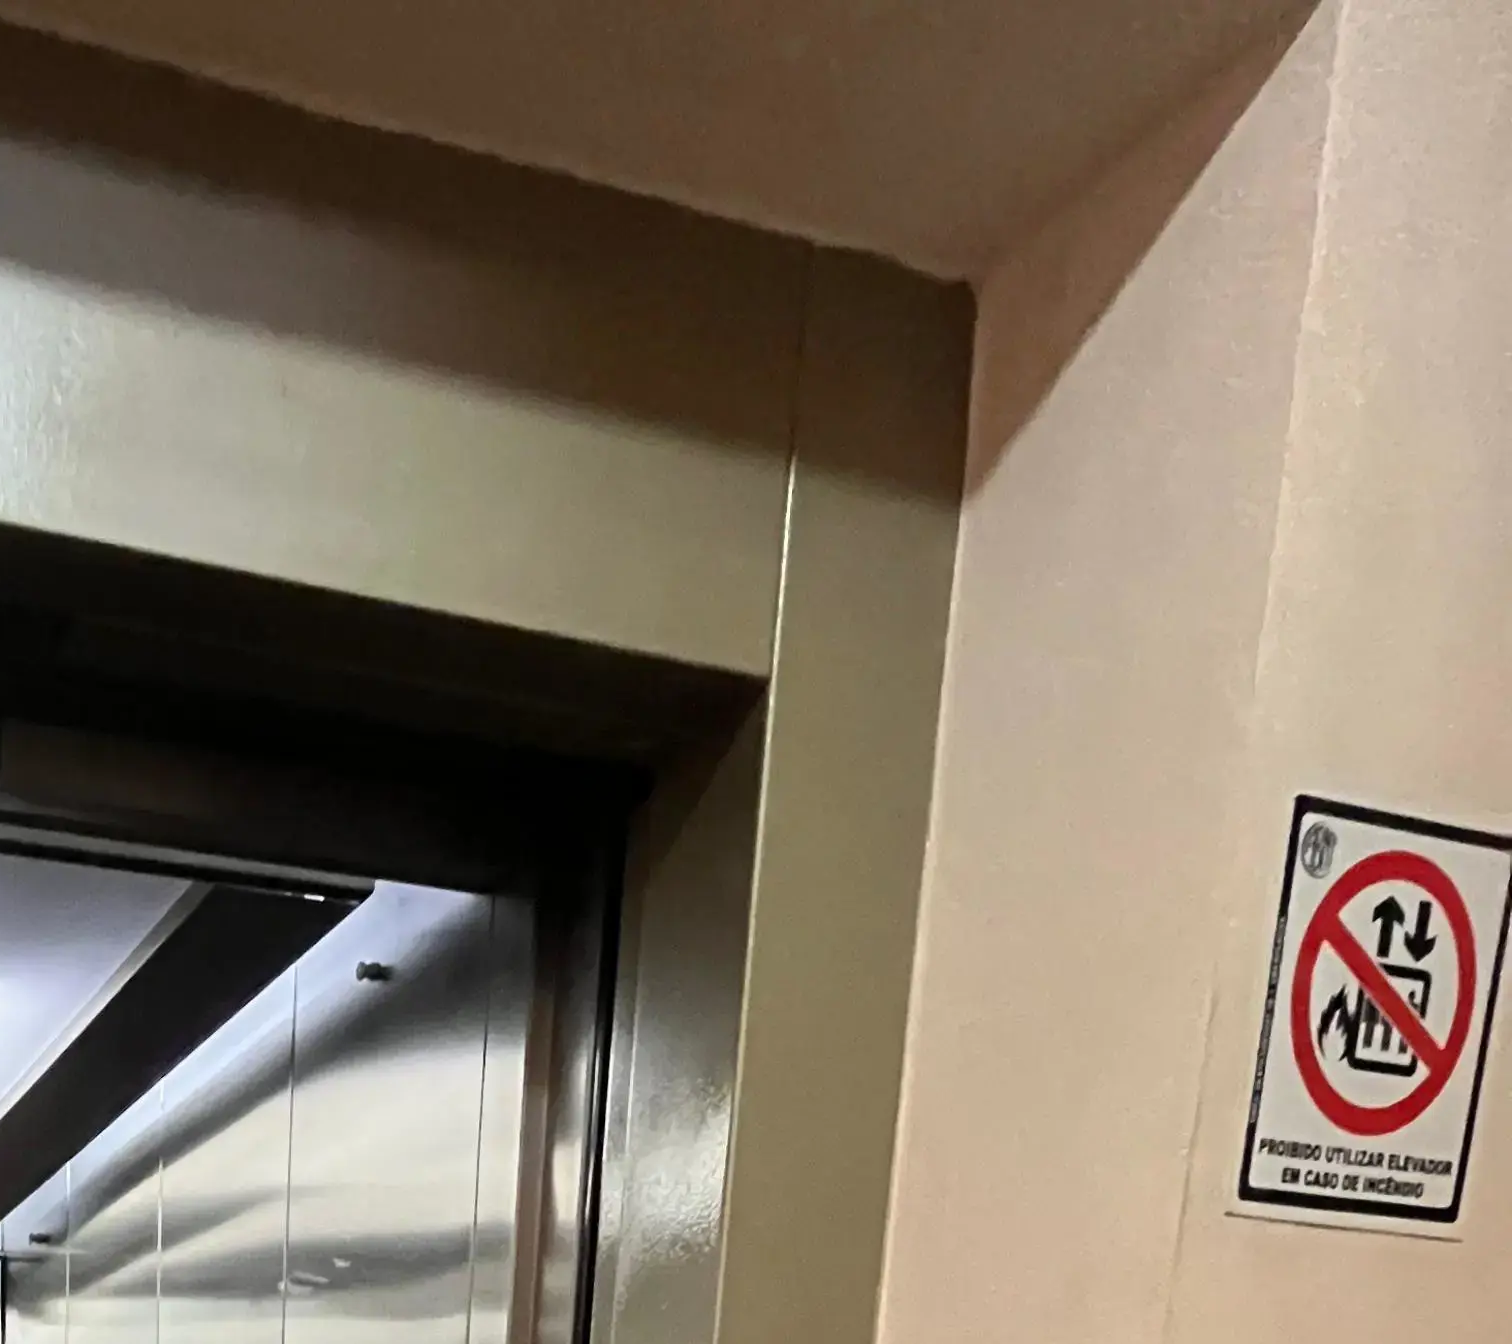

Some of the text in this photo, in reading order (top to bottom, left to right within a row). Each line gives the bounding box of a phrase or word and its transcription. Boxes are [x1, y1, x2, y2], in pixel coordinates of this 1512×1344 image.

[1259, 1138, 1453, 1175] PROIBIDO UTILIZAR ELEVADOR
[1281, 1167, 1424, 1198] EM CASO DE INCÊNDIO
